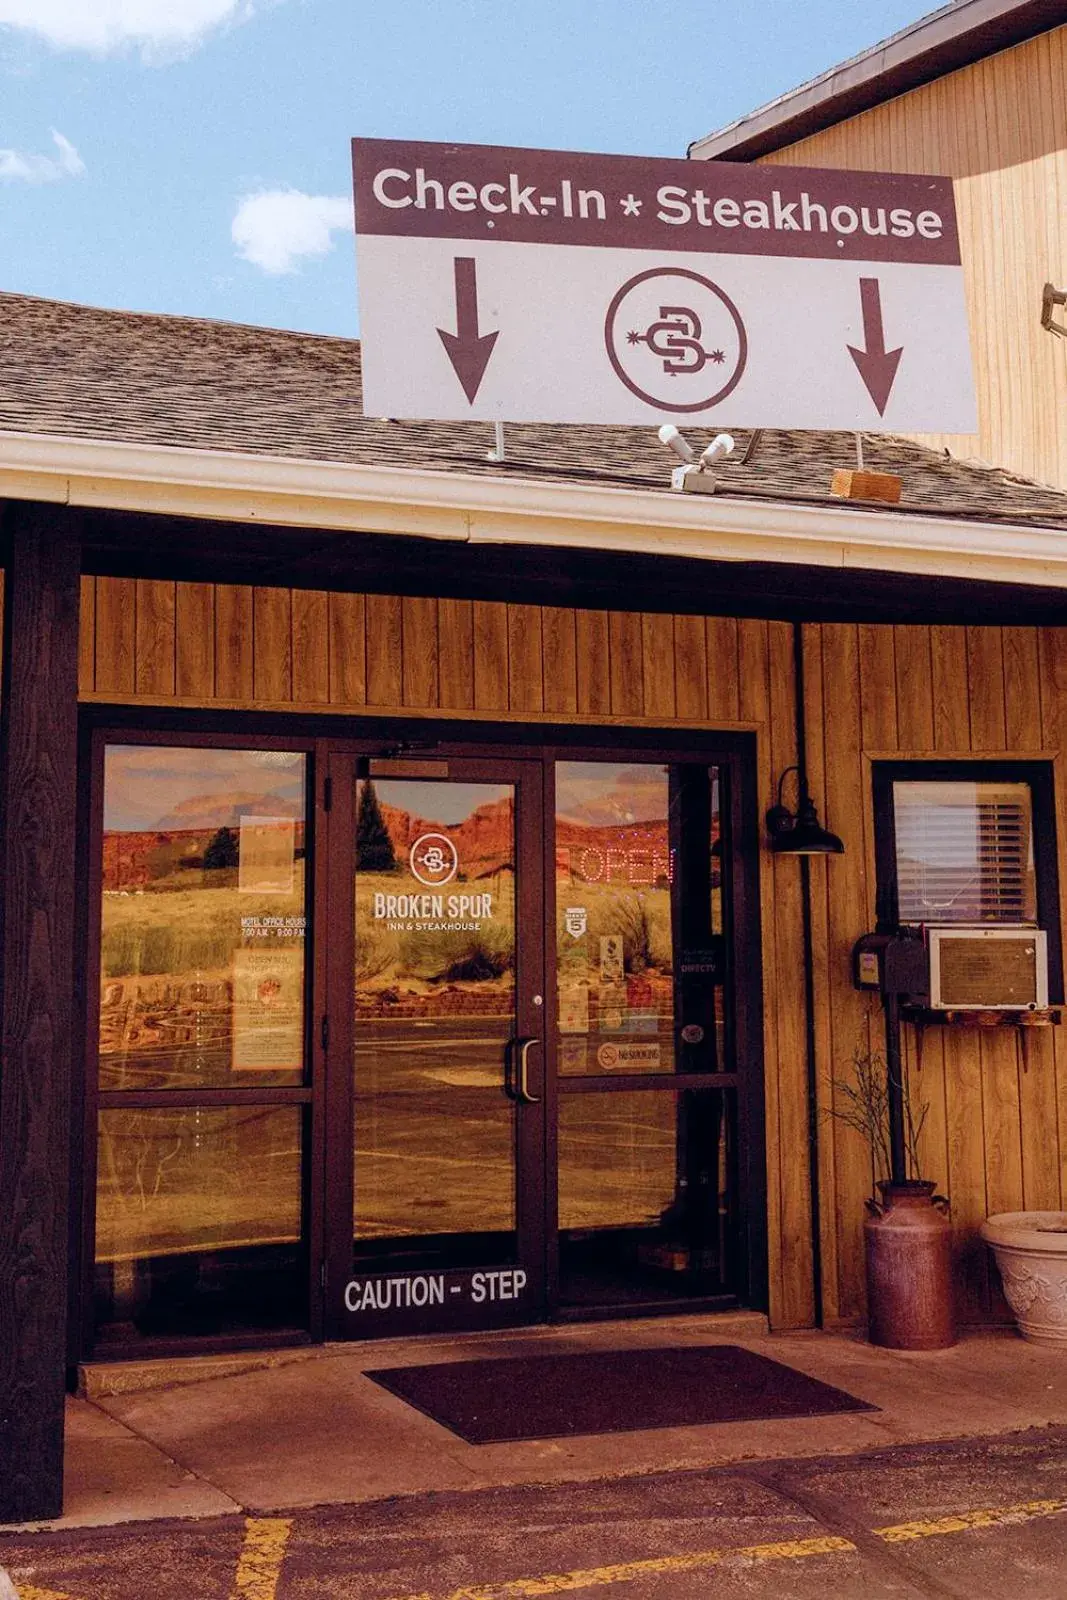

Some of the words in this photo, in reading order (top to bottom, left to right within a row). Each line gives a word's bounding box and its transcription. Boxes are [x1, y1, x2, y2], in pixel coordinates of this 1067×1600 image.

[372, 167, 607, 220] Check-In
[655, 185, 943, 239] Steakhouse
[580, 847, 677, 884] OPEN
[374, 891, 444, 919] BROKEN
[447, 892, 493, 919] SPUR
[262, 916, 284, 928] OFFICE
[285, 916, 306, 928] HOURS
[386, 922, 405, 931] INN
[406, 922, 414, 931] &
[415, 921, 482, 931] STEAKHOUSE
[344, 1275, 445, 1312] CAUTION
[471, 1270, 527, 1303] STEP
